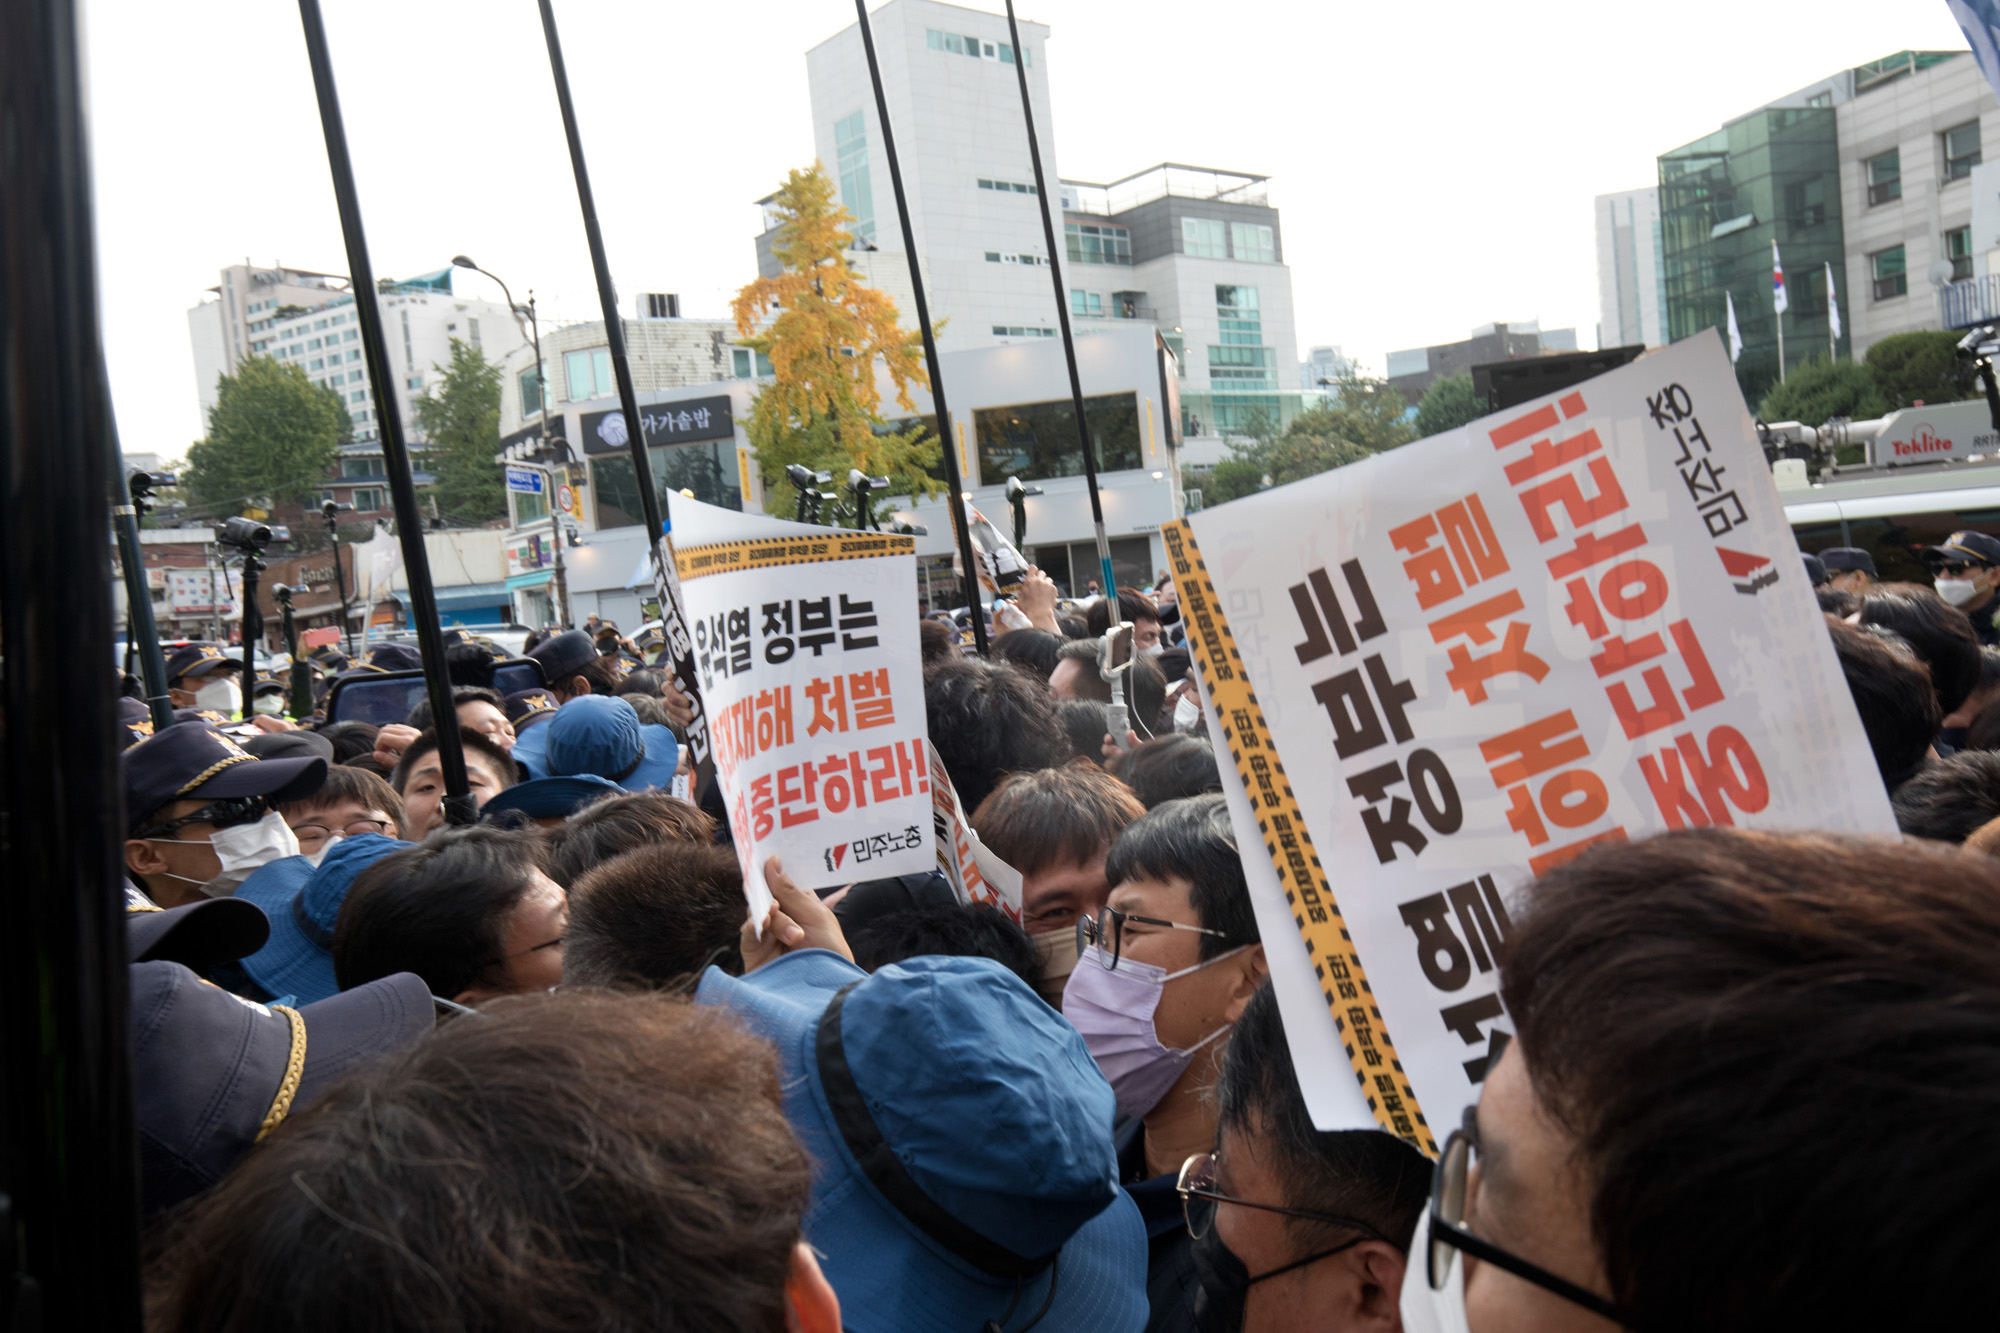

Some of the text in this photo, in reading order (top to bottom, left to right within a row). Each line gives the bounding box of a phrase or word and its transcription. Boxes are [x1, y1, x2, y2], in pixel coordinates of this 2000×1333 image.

[1646, 382, 1749, 538] 민주노총
[1891, 431, 1953, 456] Teklite
[1163, 526, 1192, 575] 무력화
[695, 606, 753, 693] 윤석열
[761, 593, 879, 664] 정부는
[1488, 390, 1770, 832] 중단하라!
[804, 667, 896, 738] 처벌
[1288, 557, 1463, 865] 정부는
[1387, 492, 1629, 878] 해 처벌
[1231, 708, 1260, 749] 중단!
[750, 737, 930, 843] 중단하라!
[1249, 754, 1282, 808] 무력화
[852, 825, 923, 864] 민주노총
[1271, 813, 1328, 924] 중대재해처벌
[1326, 954, 1359, 999] 중단!
[1347, 1006, 1383, 1067] 무력화
